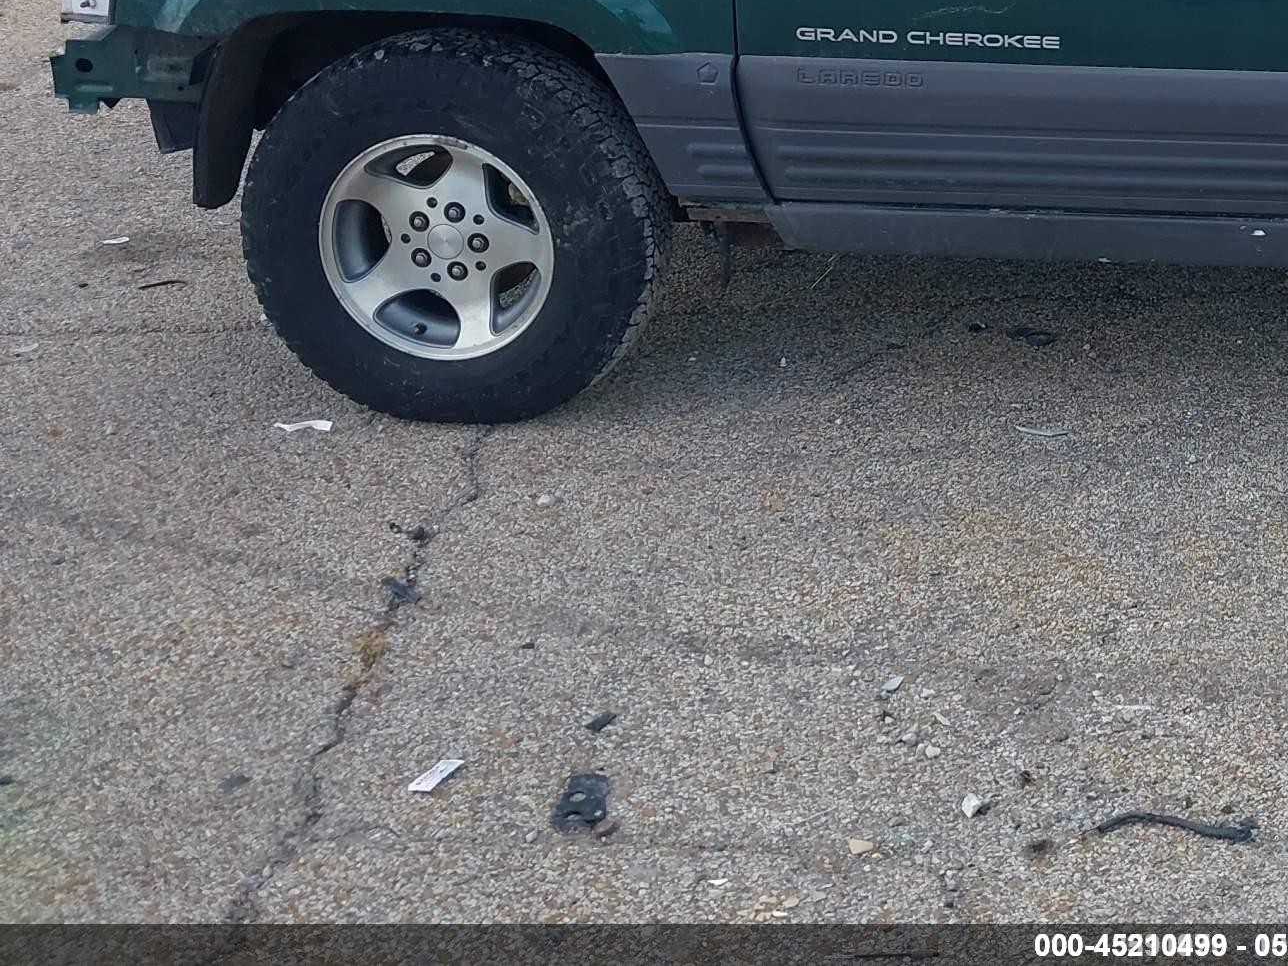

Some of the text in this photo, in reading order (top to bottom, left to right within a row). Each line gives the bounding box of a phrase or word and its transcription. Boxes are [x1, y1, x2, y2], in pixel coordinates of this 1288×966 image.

[795, 27, 1061, 49] GRAND CHEROKEE
[796, 67, 925, 88] LAREDO
